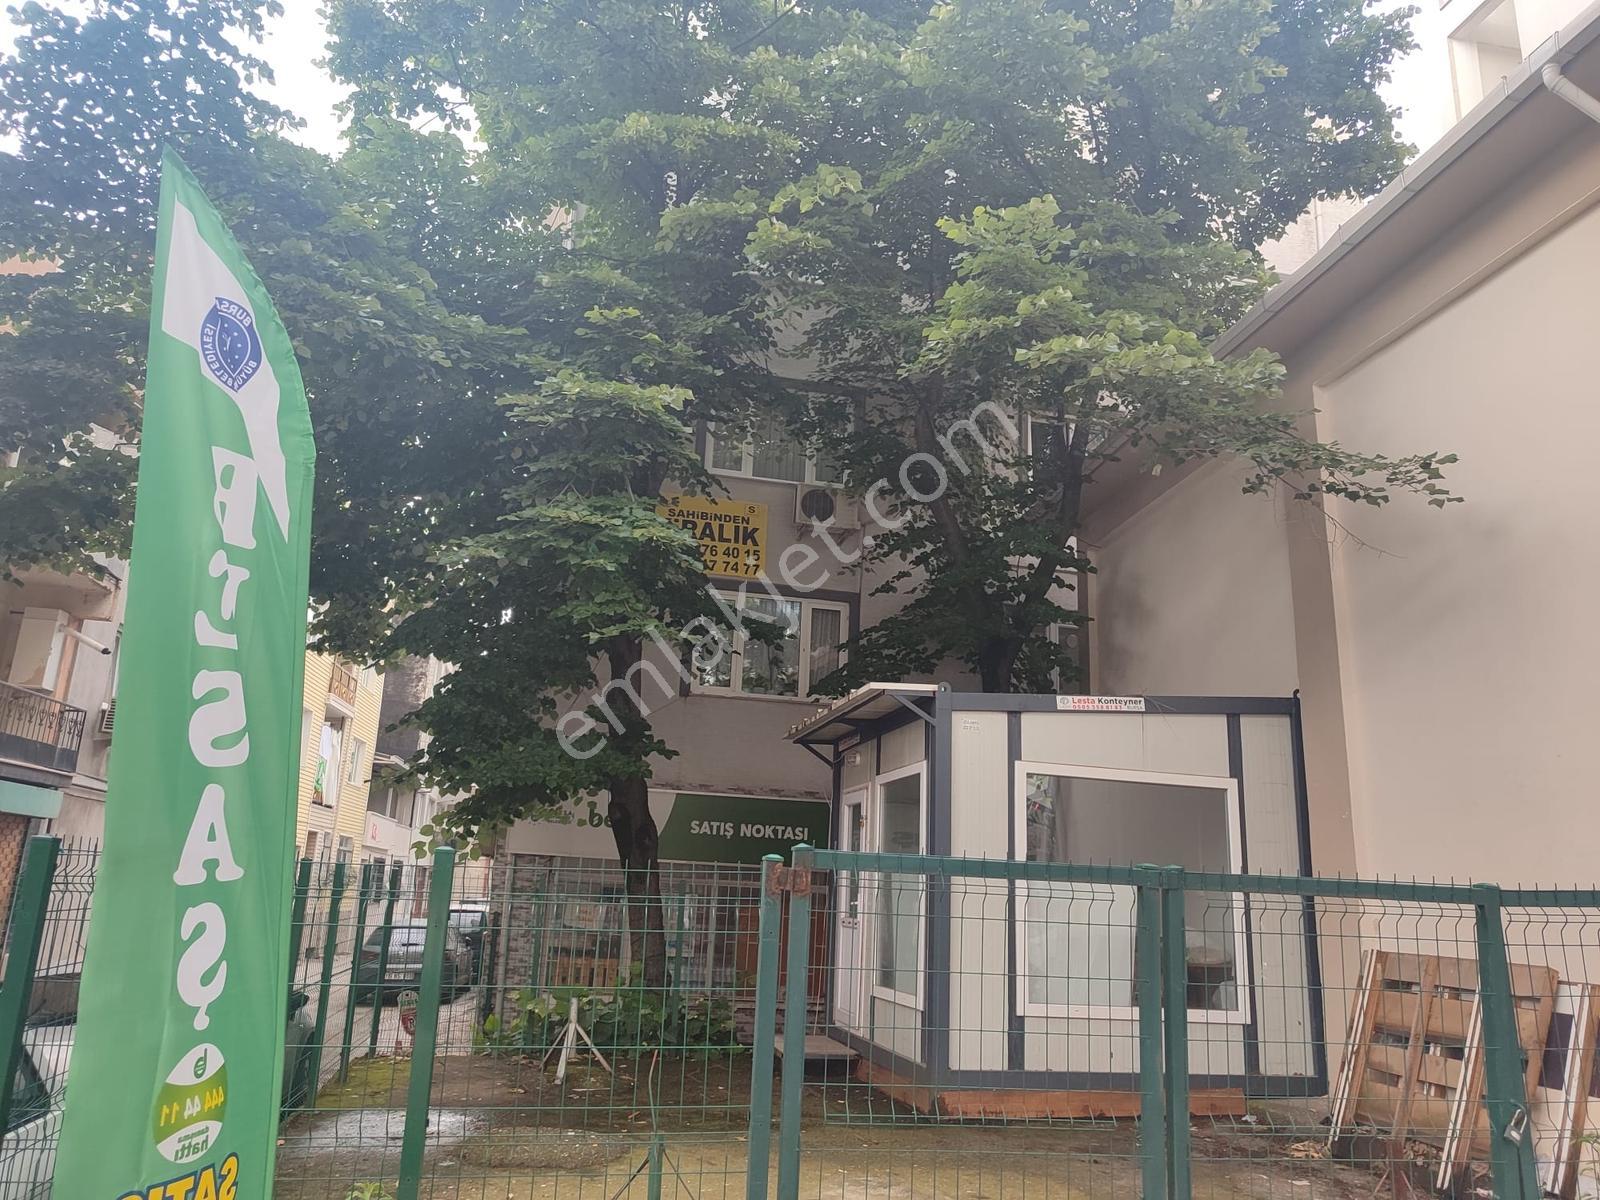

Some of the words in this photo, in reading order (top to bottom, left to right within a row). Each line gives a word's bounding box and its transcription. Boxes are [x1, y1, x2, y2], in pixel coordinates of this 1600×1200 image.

[748, 505, 756, 514] S
[665, 518, 759, 547] RALIK
[722, 547, 739, 559] 40
[744, 549, 760, 561] 15
[723, 562, 739, 574] 74
[743, 563, 760, 576] 77
[1072, 697, 1096, 705] Lesta
[1097, 697, 1142, 706] Konteyner
[690, 820, 735, 839] SATIŞ
[740, 823, 809, 841] NOKTASI
